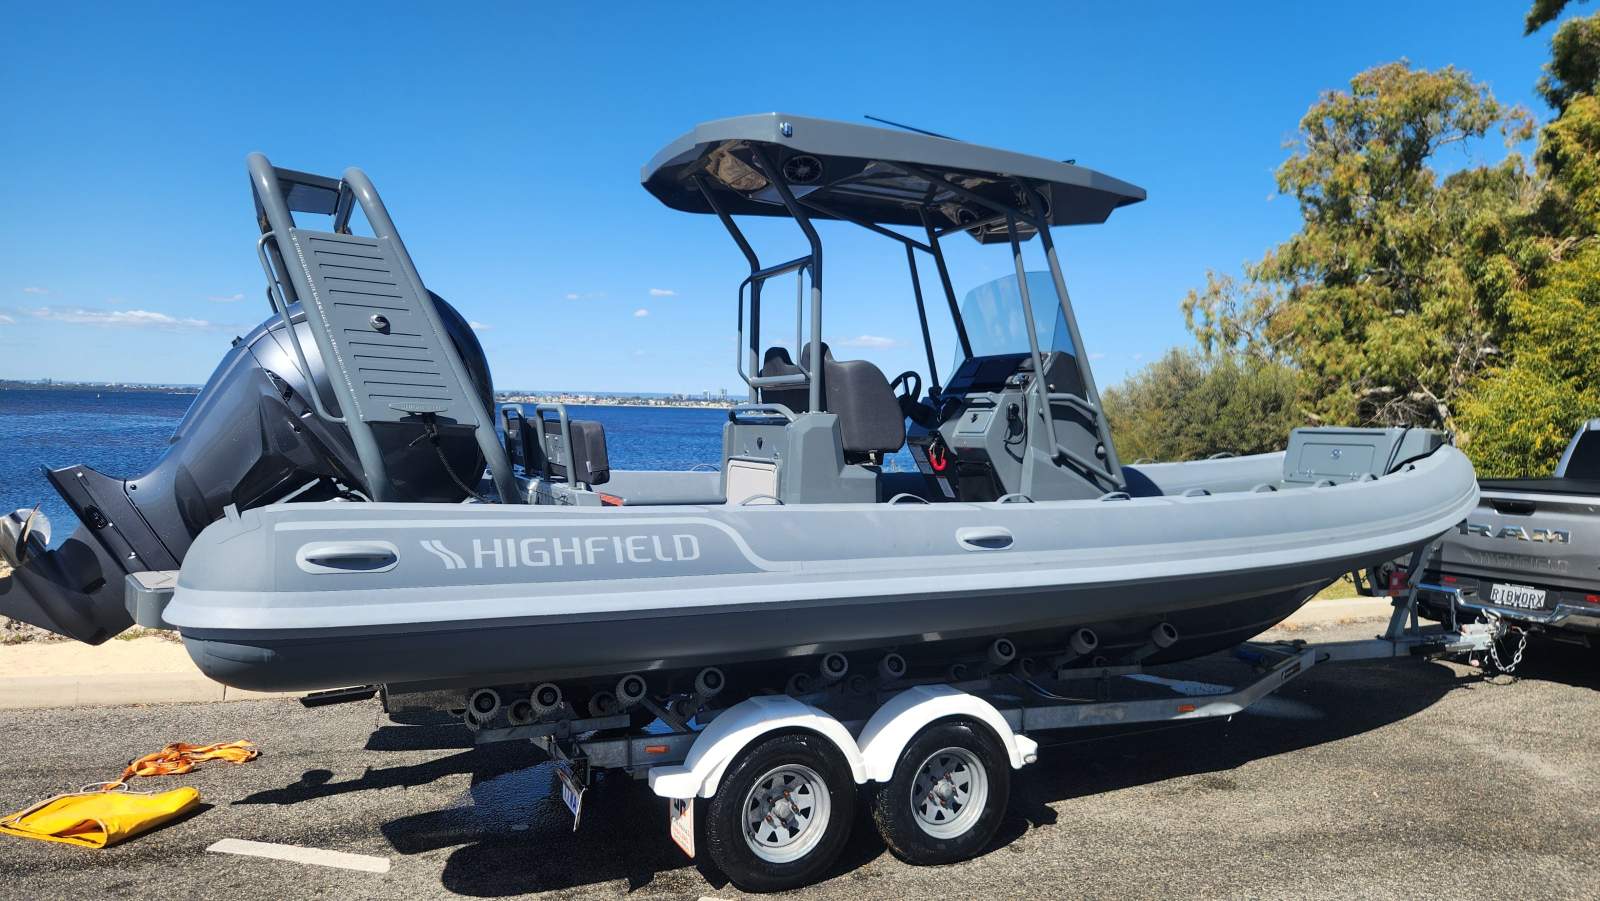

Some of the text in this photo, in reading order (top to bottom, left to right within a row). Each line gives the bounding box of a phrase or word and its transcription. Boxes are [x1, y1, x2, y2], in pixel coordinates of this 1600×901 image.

[1457, 519, 1570, 543] RAM
[473, 534, 700, 568] HIGHFIELD
[1491, 588, 1544, 607] RIBWORX
